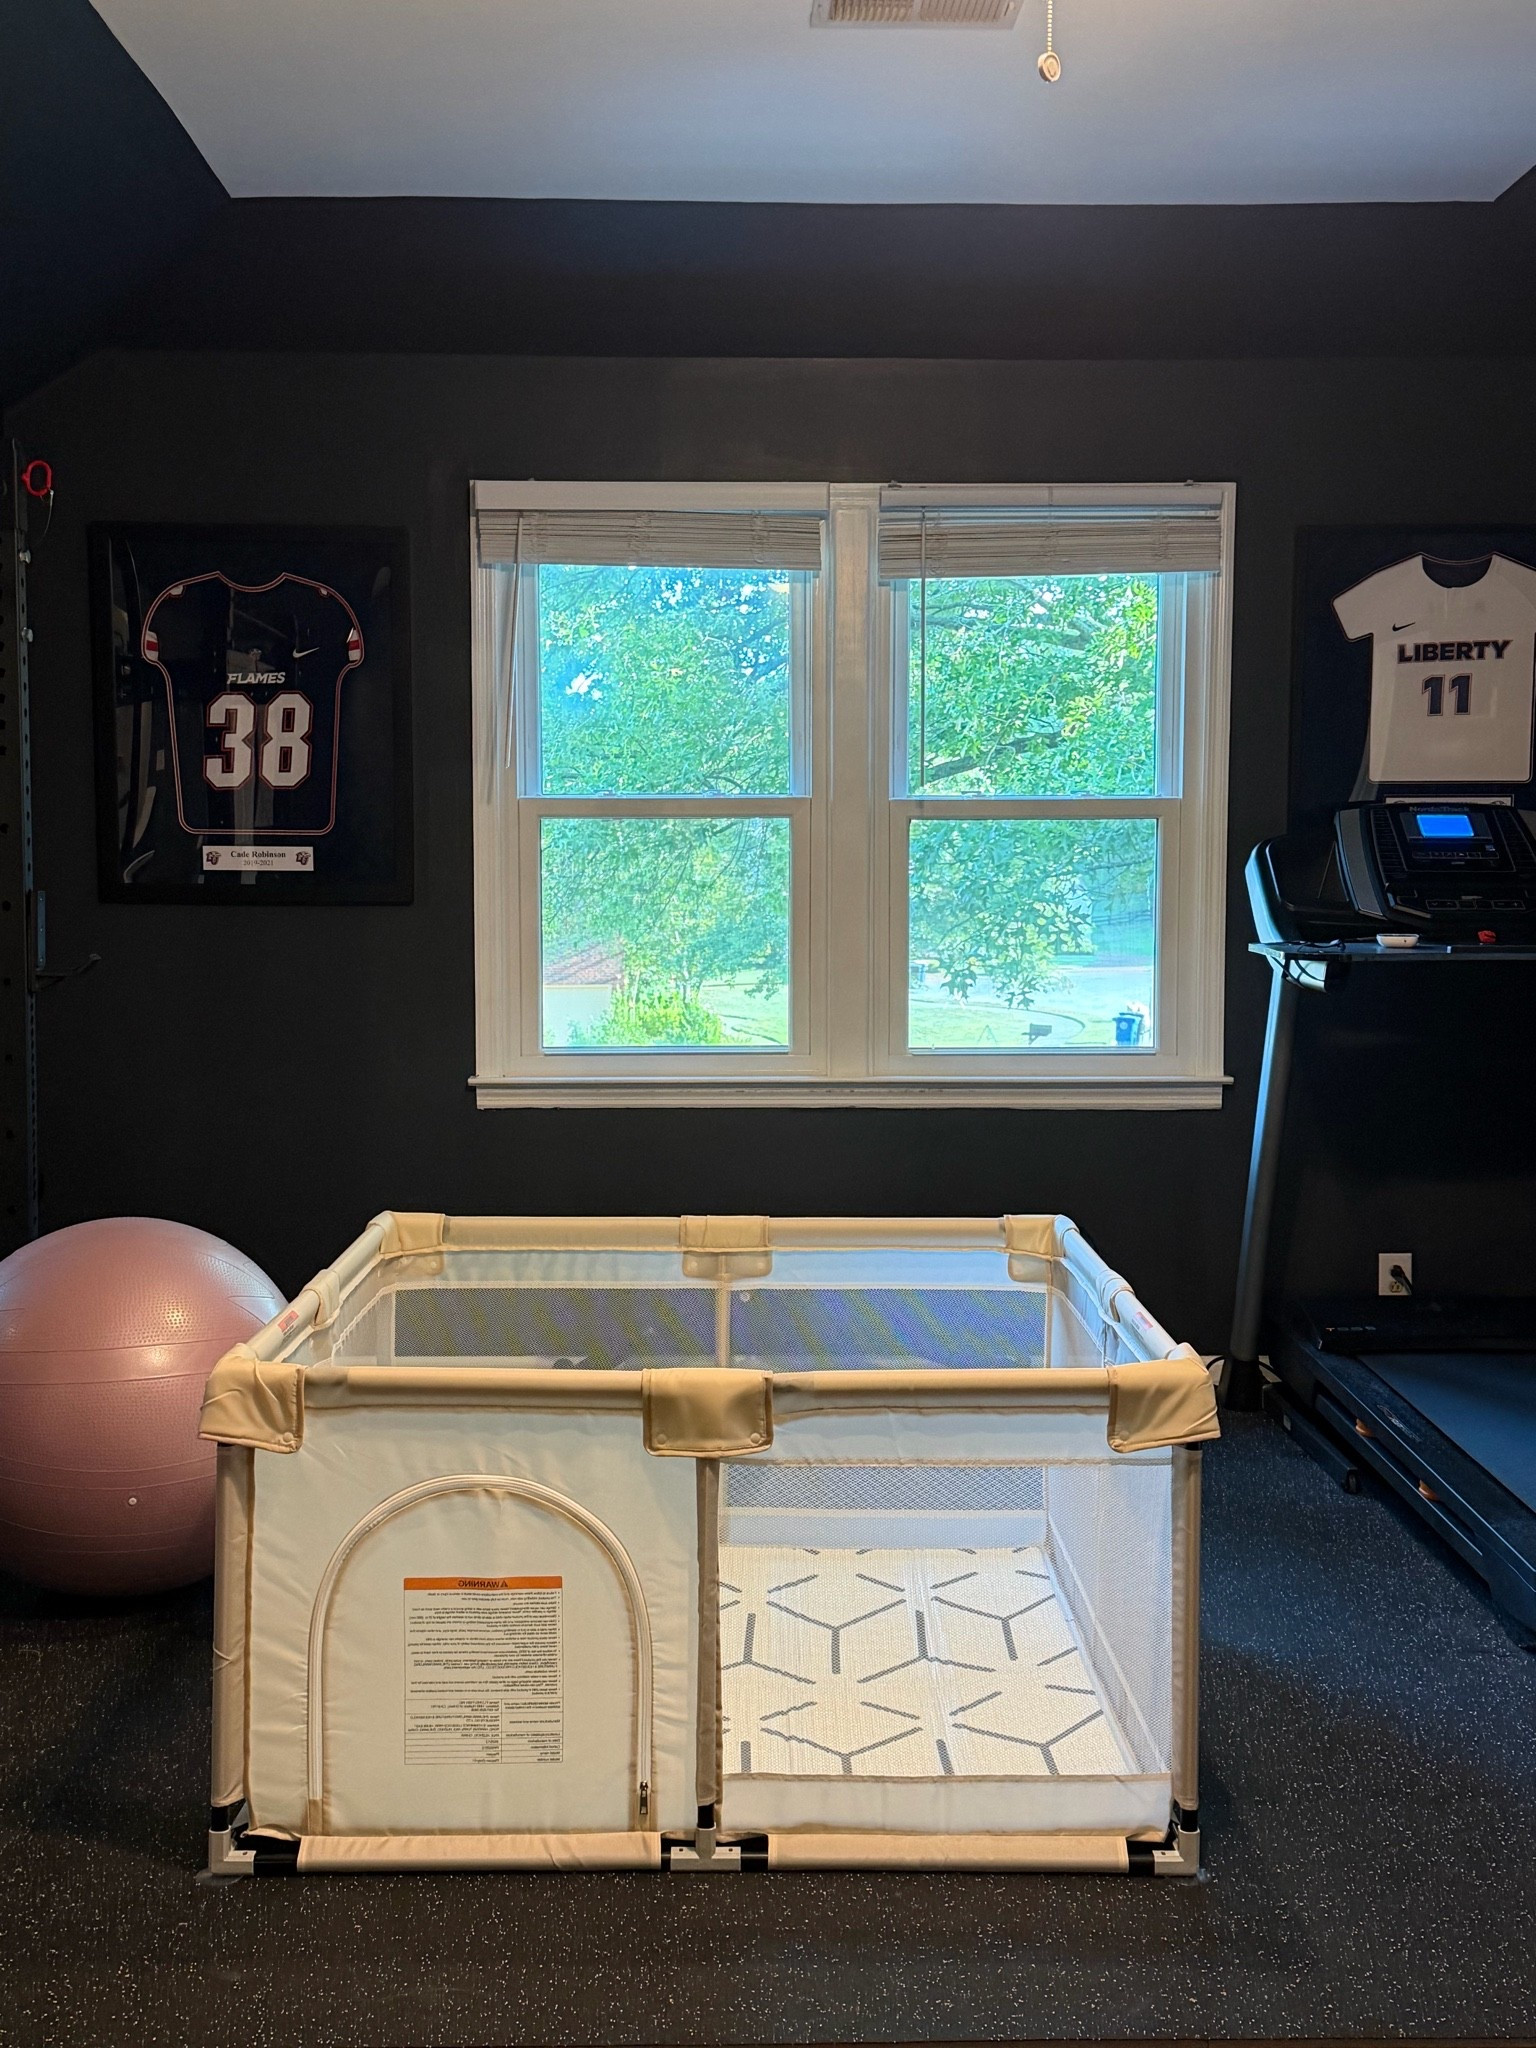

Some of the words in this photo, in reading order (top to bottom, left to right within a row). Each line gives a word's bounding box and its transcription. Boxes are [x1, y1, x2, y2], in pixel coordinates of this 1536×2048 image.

[1397, 640, 1513, 664] LIBERTY
[227, 672, 286, 684] FLAMES
[1422, 673, 1472, 716] 11
[203, 691, 313, 790] 38
[230, 850, 250, 858] Cade
[252, 850, 286, 858] Robinson
